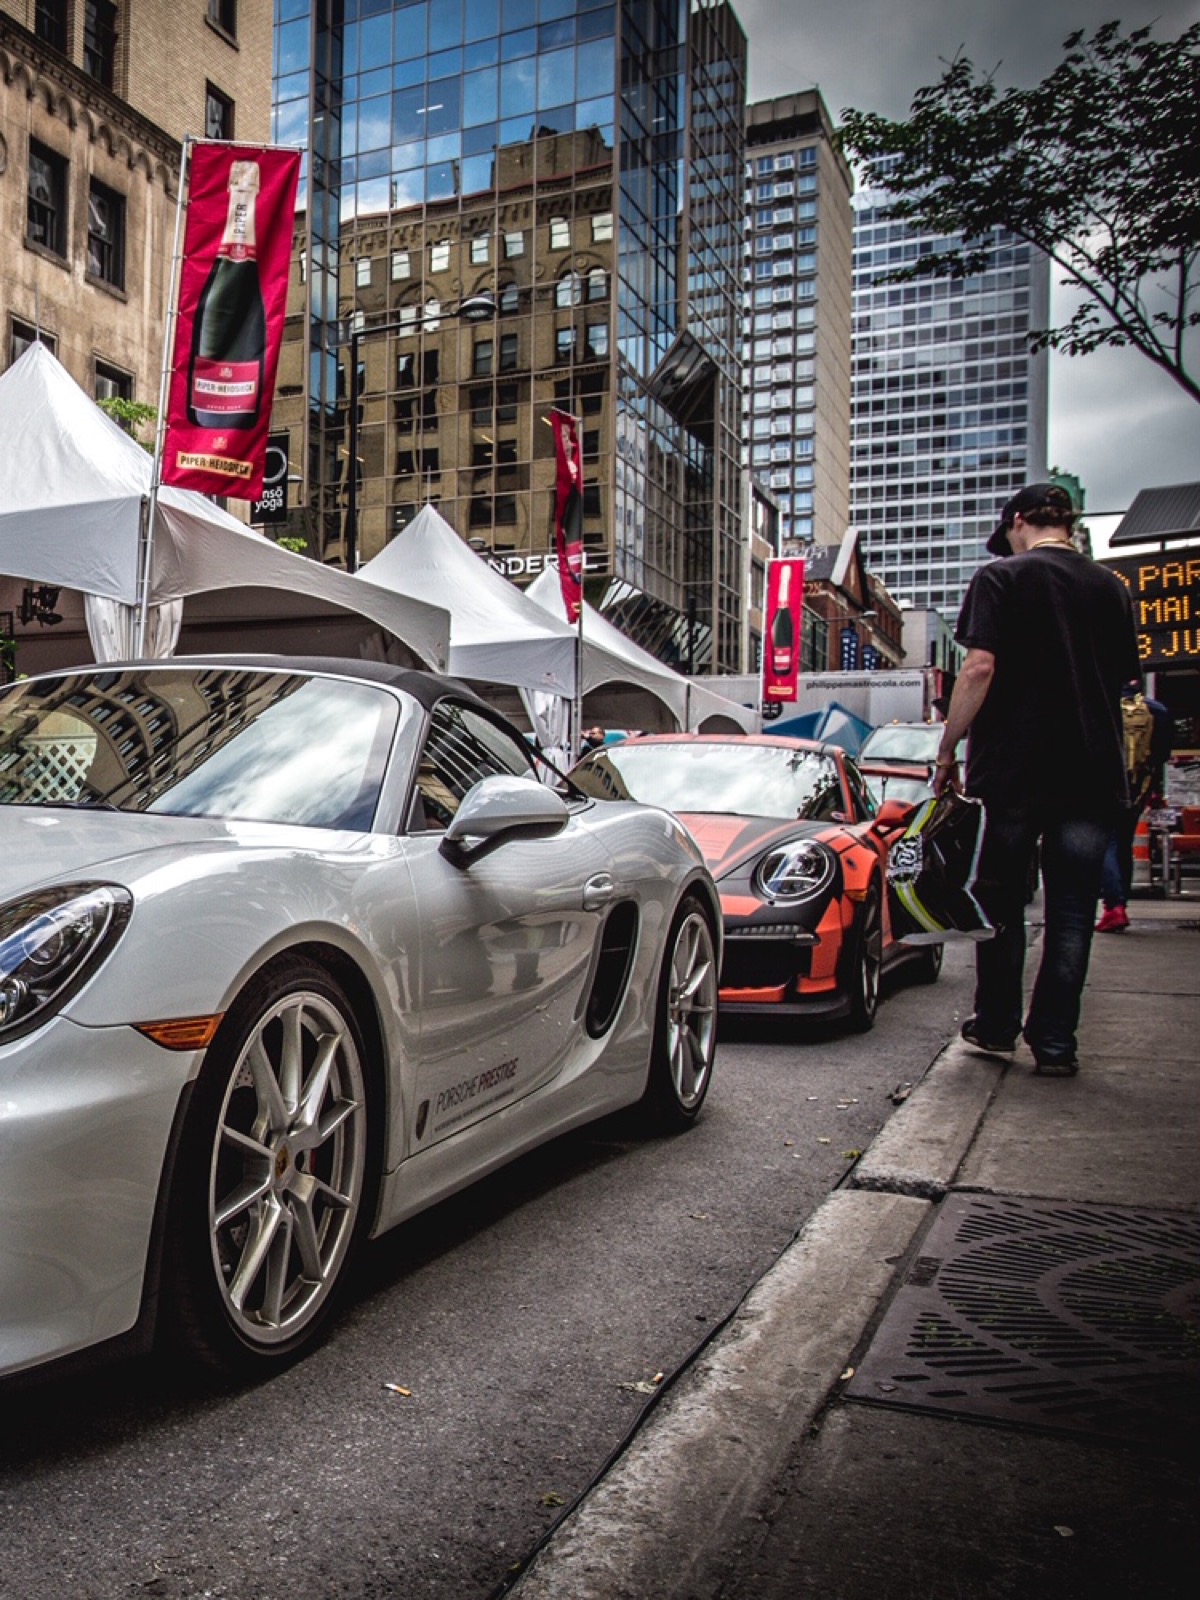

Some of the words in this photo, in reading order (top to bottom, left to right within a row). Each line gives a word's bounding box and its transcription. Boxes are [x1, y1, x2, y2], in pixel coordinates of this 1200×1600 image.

[234, 203, 247, 234] PIPER
[262, 486, 283, 499] nsō
[255, 499, 283, 513] yoga
[806, 680, 921, 690] philippemastrocola.com
[436, 1075, 480, 1114] PORSCHE
[478, 1057, 519, 1093] PRESTIGE
